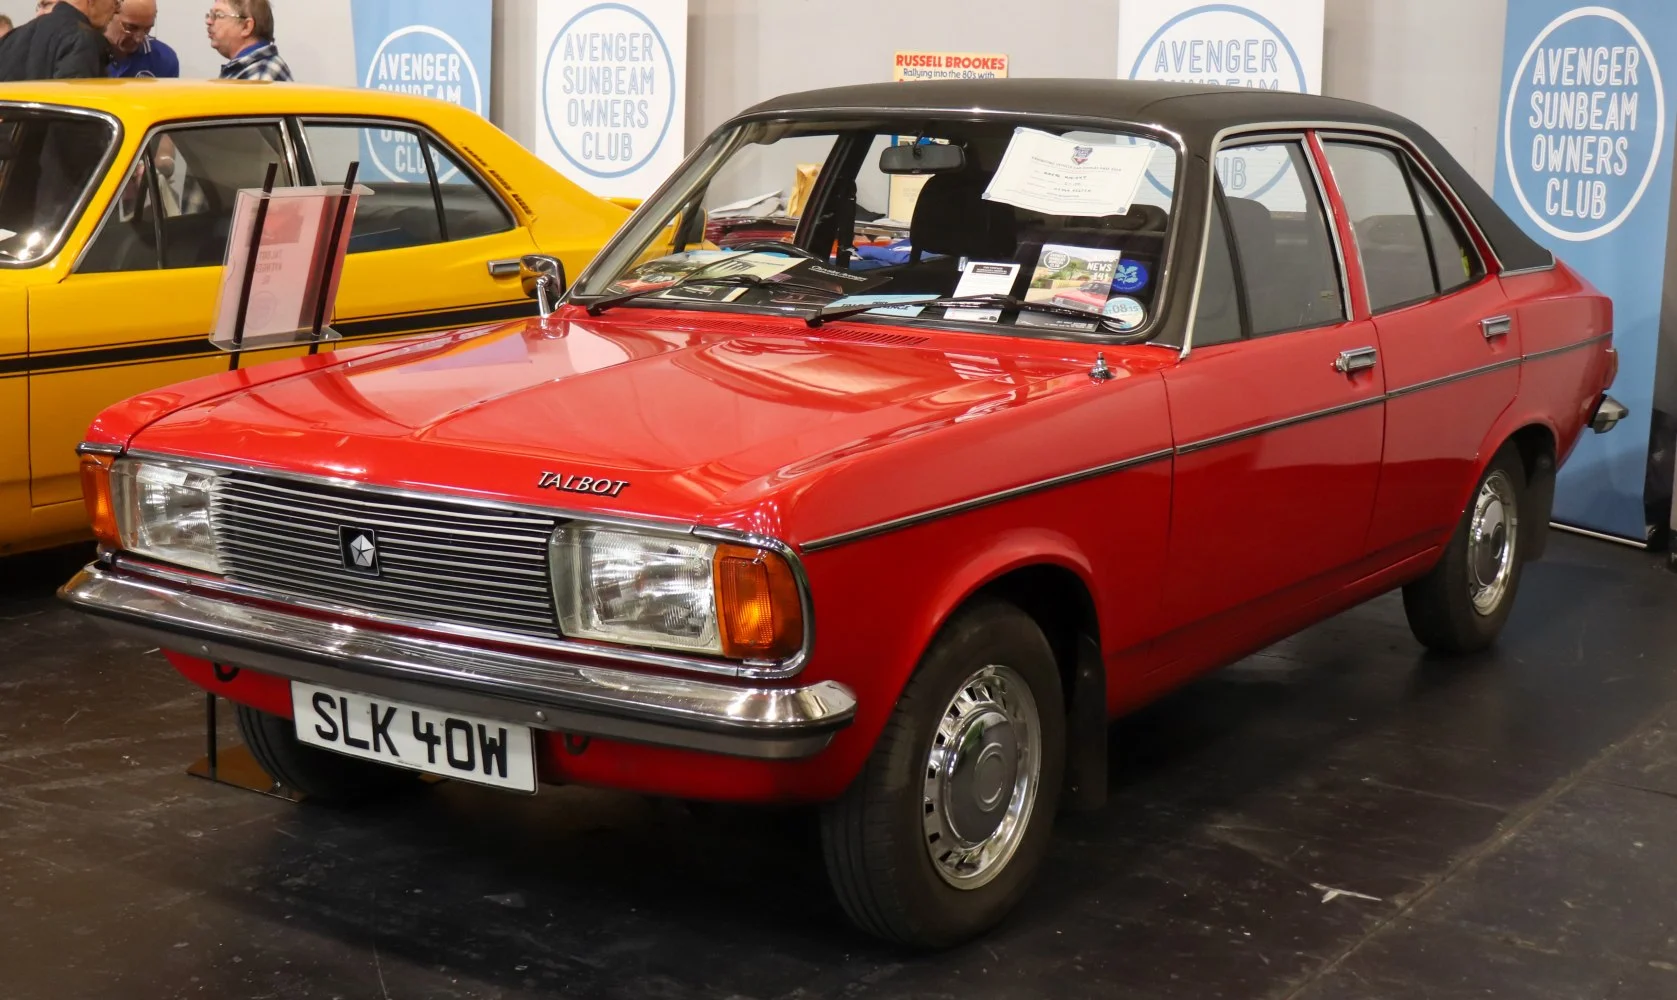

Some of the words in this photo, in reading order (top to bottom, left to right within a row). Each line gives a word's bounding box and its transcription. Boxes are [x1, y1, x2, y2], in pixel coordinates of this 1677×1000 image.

[563, 32, 654, 62] AVENGER
[896, 54, 942, 68] RUSSELL
[945, 56, 1005, 70] BROOKES
[1154, 40, 1278, 74] AVENGER
[378, 53, 461, 82] AVENGER
[562, 66, 655, 96] SUNBEAM
[903, 68, 932, 79] Rallying
[933, 70, 948, 78] into
[948, 70, 961, 78] the
[977, 71, 995, 80] with
[1532, 46, 1640, 87] AVENGER
[566, 99, 649, 129] OWNERS
[1528, 90, 1639, 132] SUNBEAM
[581, 132, 633, 162] CLUB
[1531, 133, 1629, 177] OWNERS
[1545, 178, 1607, 220] CLUB
[1086, 262, 1112, 272] NEWS
[537, 470, 630, 498] TALBOT
[312, 691, 400, 757] SLK
[412, 710, 508, 778] 40W
